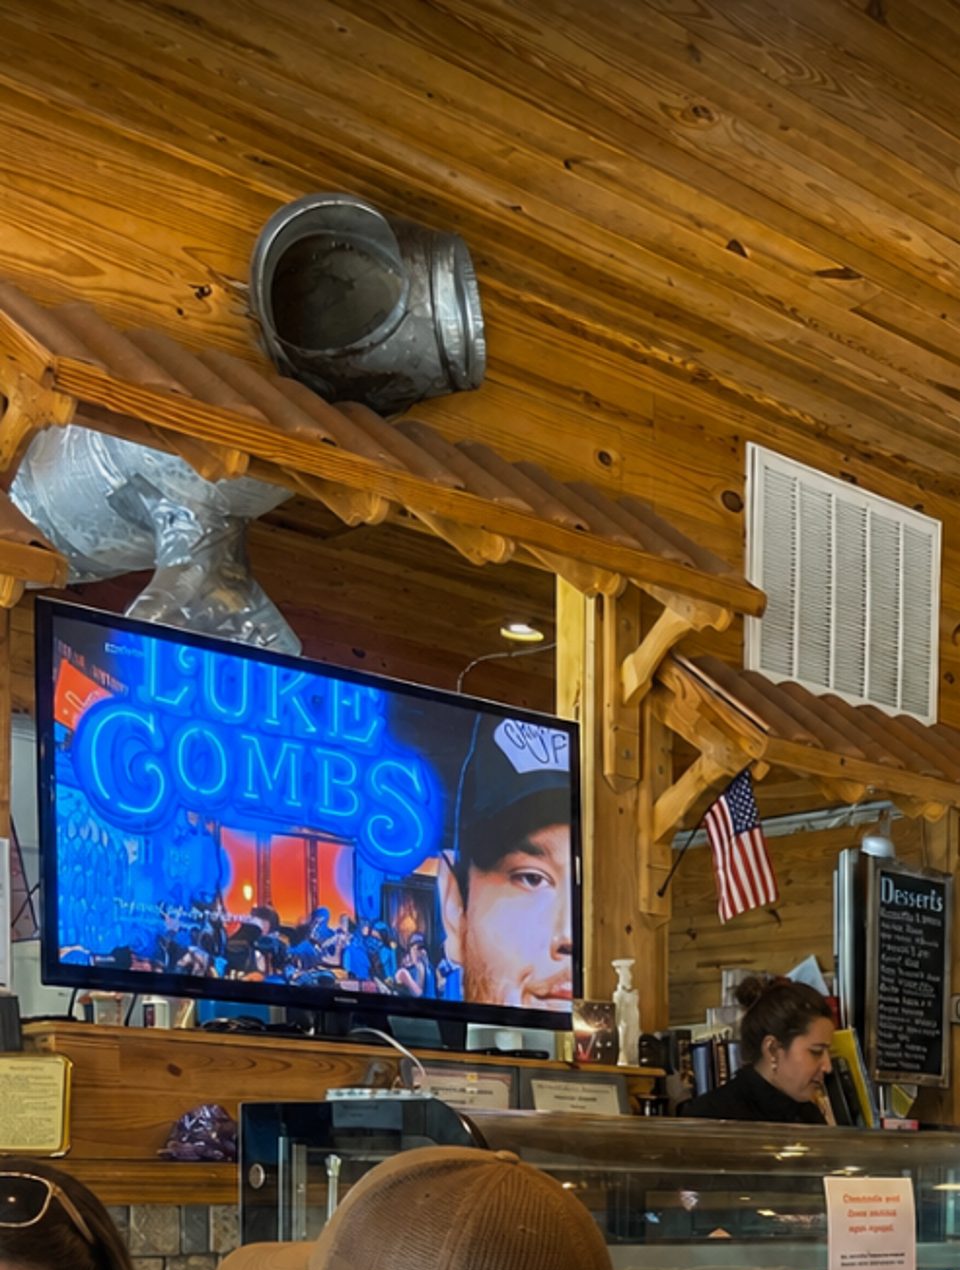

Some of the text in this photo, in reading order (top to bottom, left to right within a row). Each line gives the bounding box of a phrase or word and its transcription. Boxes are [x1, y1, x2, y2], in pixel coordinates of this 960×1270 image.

[142, 634, 380, 744] LUKE
[86, 706, 429, 861] COMBS
[881, 876, 943, 912] Desserts
